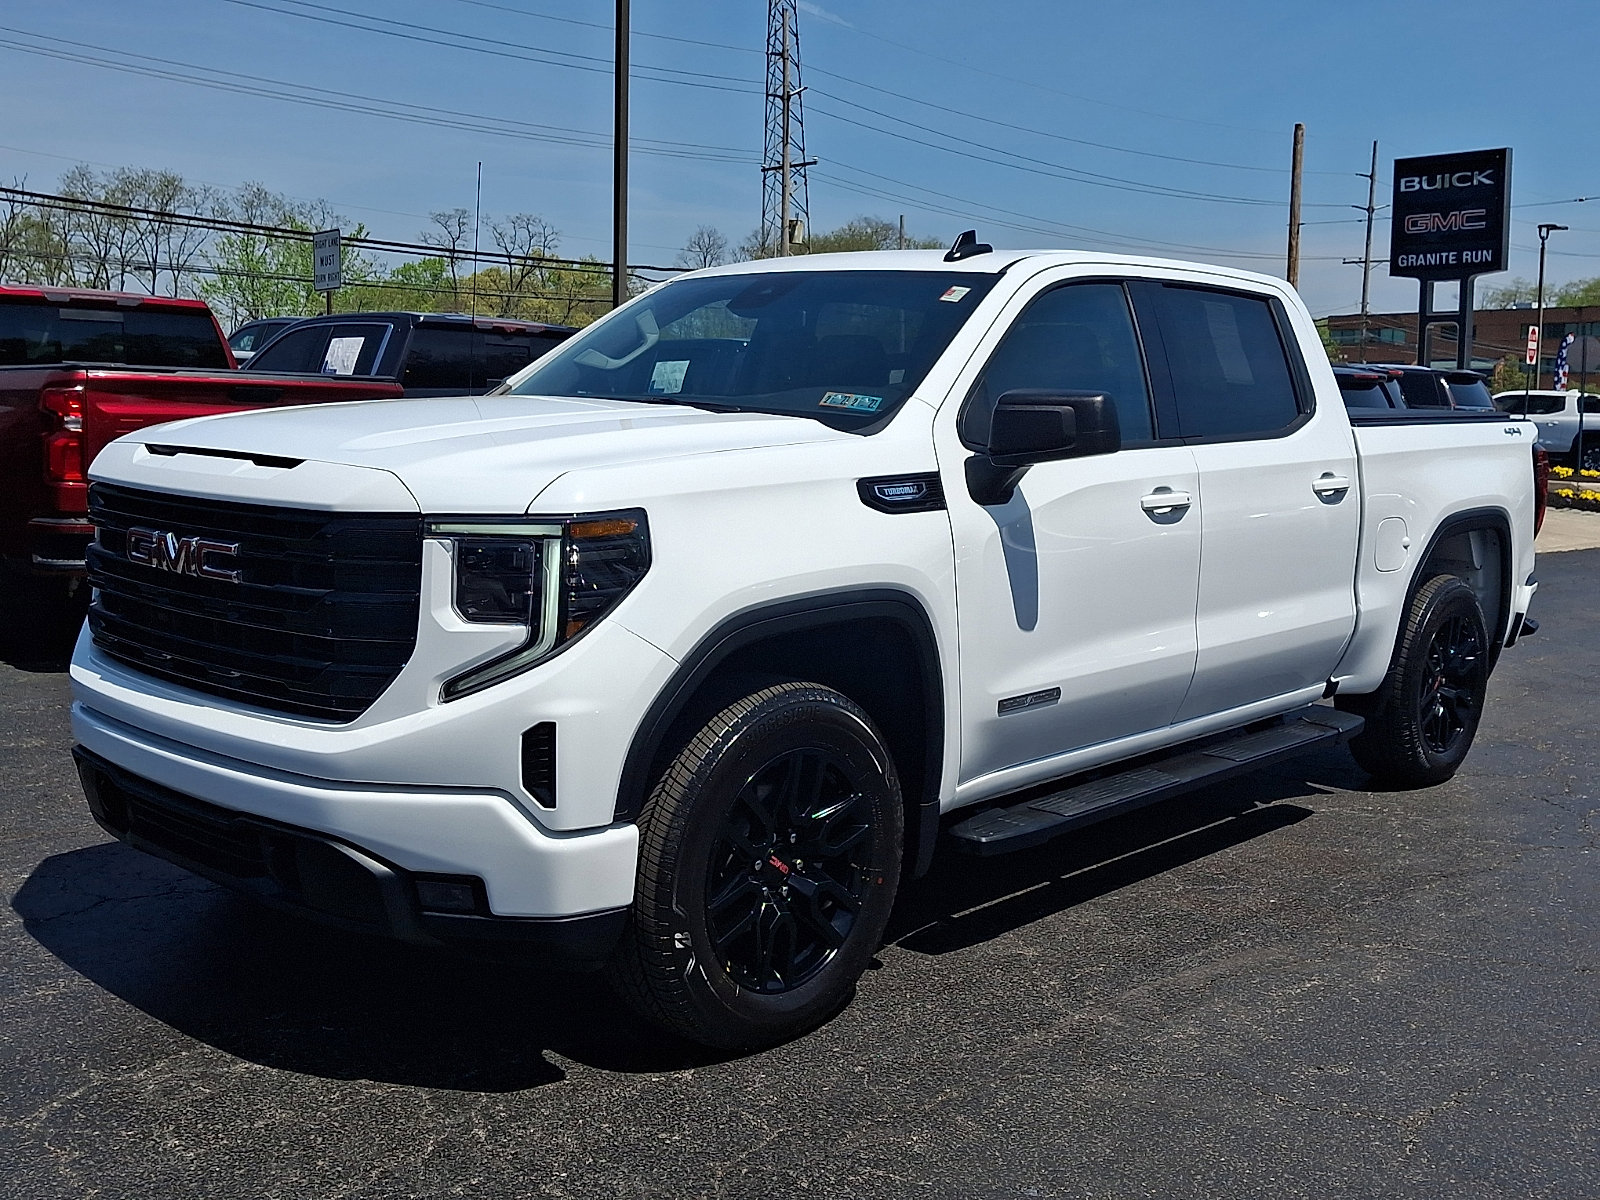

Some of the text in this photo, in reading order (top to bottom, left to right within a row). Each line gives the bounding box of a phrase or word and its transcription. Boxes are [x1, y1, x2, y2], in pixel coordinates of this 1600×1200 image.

[1400, 169, 1495, 193] BUICK
[1404, 208, 1486, 234] GMC
[315, 236, 339, 249] RIGHT LANE
[320, 254, 335, 267] MUST
[1398, 250, 1493, 267] GRANITE RUN
[315, 271, 340, 284] TURN RIGHT
[126, 527, 242, 584] GMC
